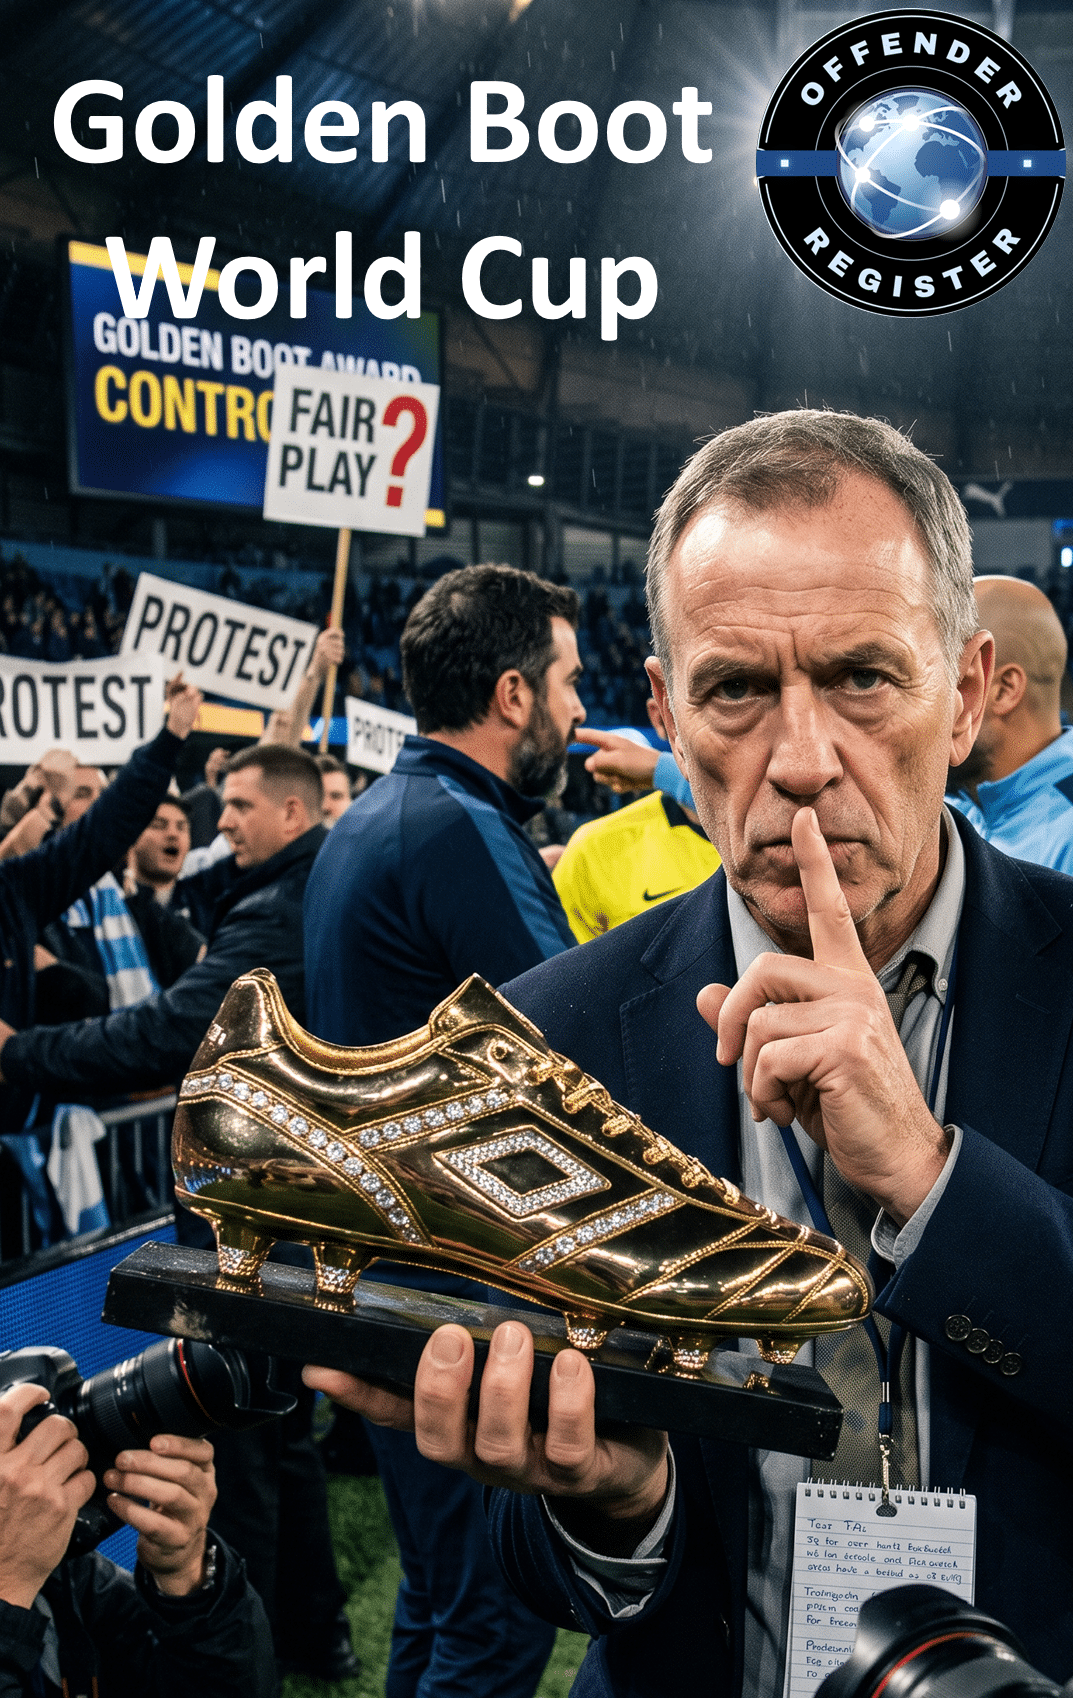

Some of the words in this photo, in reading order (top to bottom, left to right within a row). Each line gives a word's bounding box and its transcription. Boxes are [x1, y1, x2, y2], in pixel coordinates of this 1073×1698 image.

[93, 312, 224, 371] GOLDEN
[289, 386, 377, 443] FAIR
[279, 444, 377, 498] PLAY
[382, 394, 428, 507] ?
[133, 595, 306, 691] PROTEST
